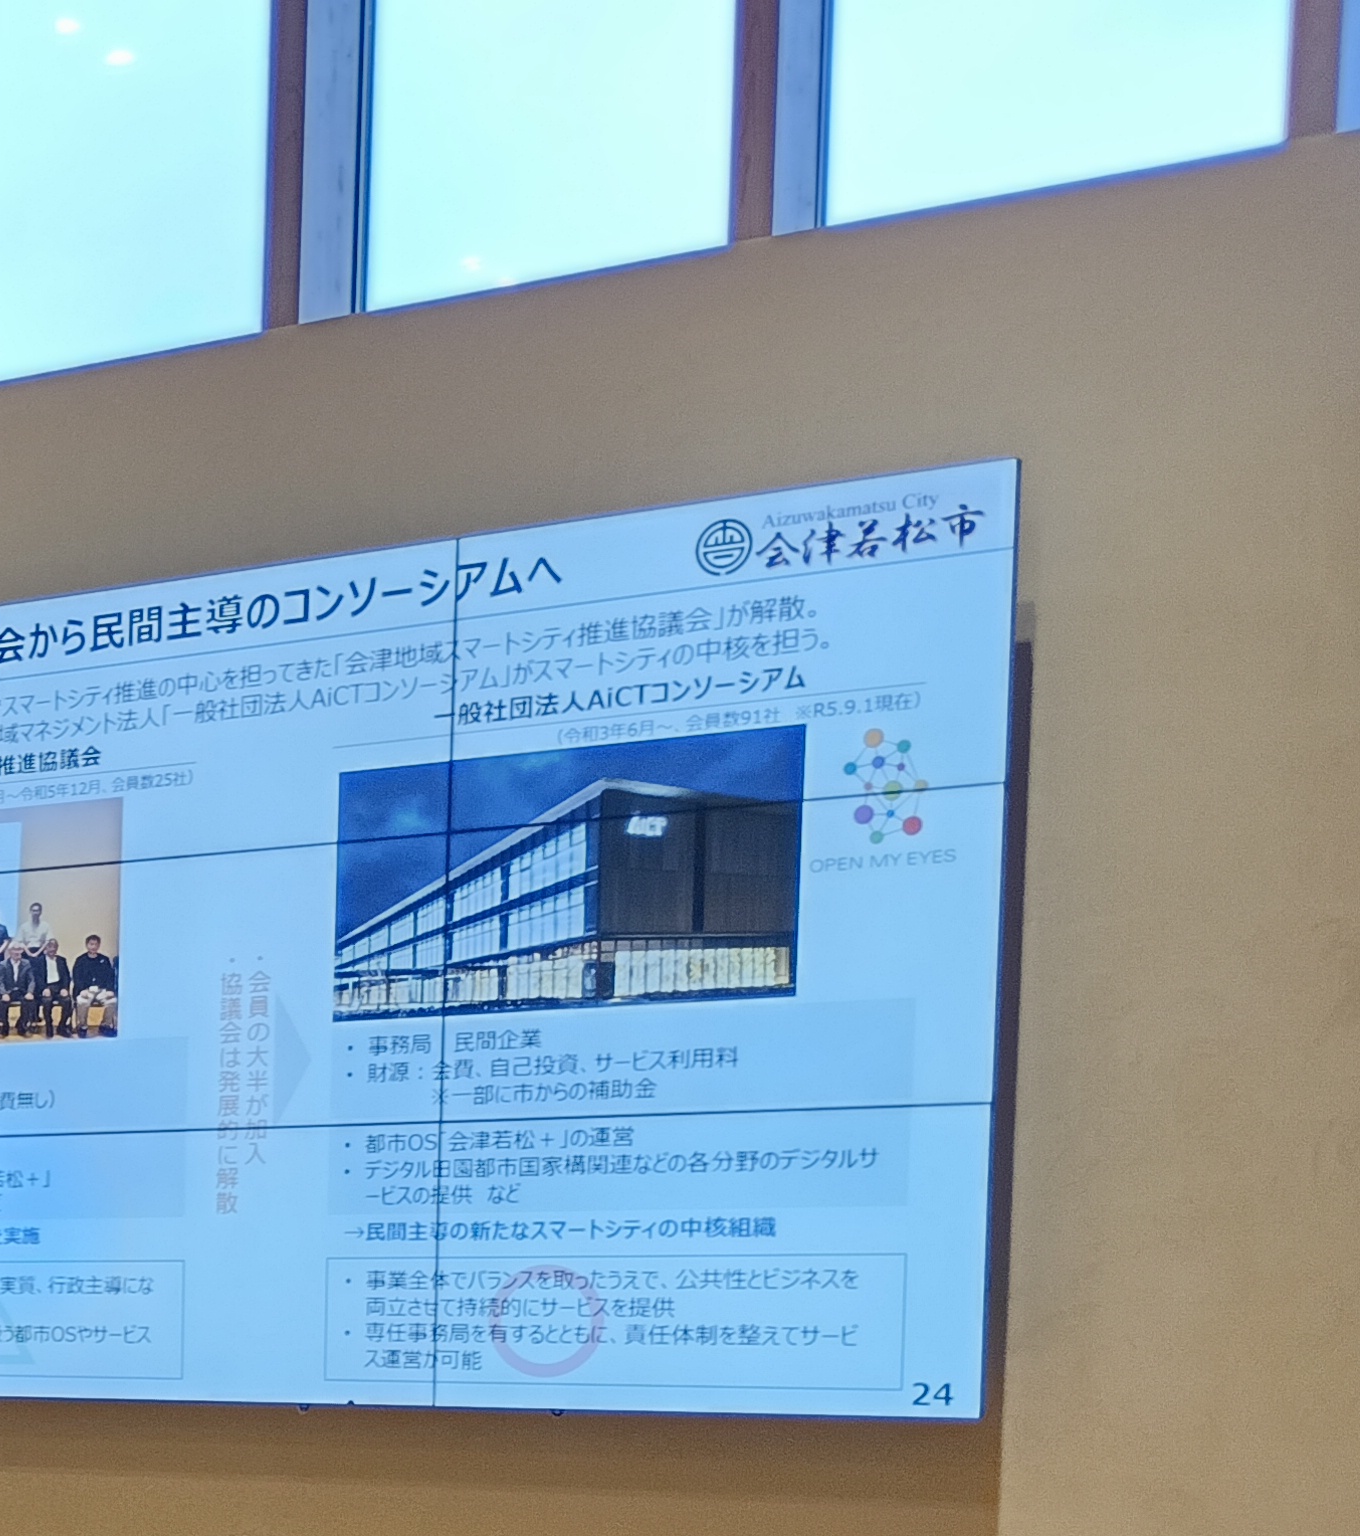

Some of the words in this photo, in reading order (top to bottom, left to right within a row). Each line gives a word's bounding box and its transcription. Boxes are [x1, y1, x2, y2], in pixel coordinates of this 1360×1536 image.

[761, 500, 897, 529] Aizuwakamatsu
[901, 492, 940, 512] City
[754, 503, 985, 569] 会津若松市
[434, 667, 807, 725] 一般社団法人AiCTコンソーシアム
[809, 855, 863, 873] OPEN
[869, 852, 902, 868] MY
[907, 848, 958, 866] EYES
[243, 970, 271, 1166] 会員の大半が加入
[215, 972, 243, 1216] 協議会は発展的に解散
[487, 1183, 522, 1205] など
[911, 1382, 954, 1407] 24
